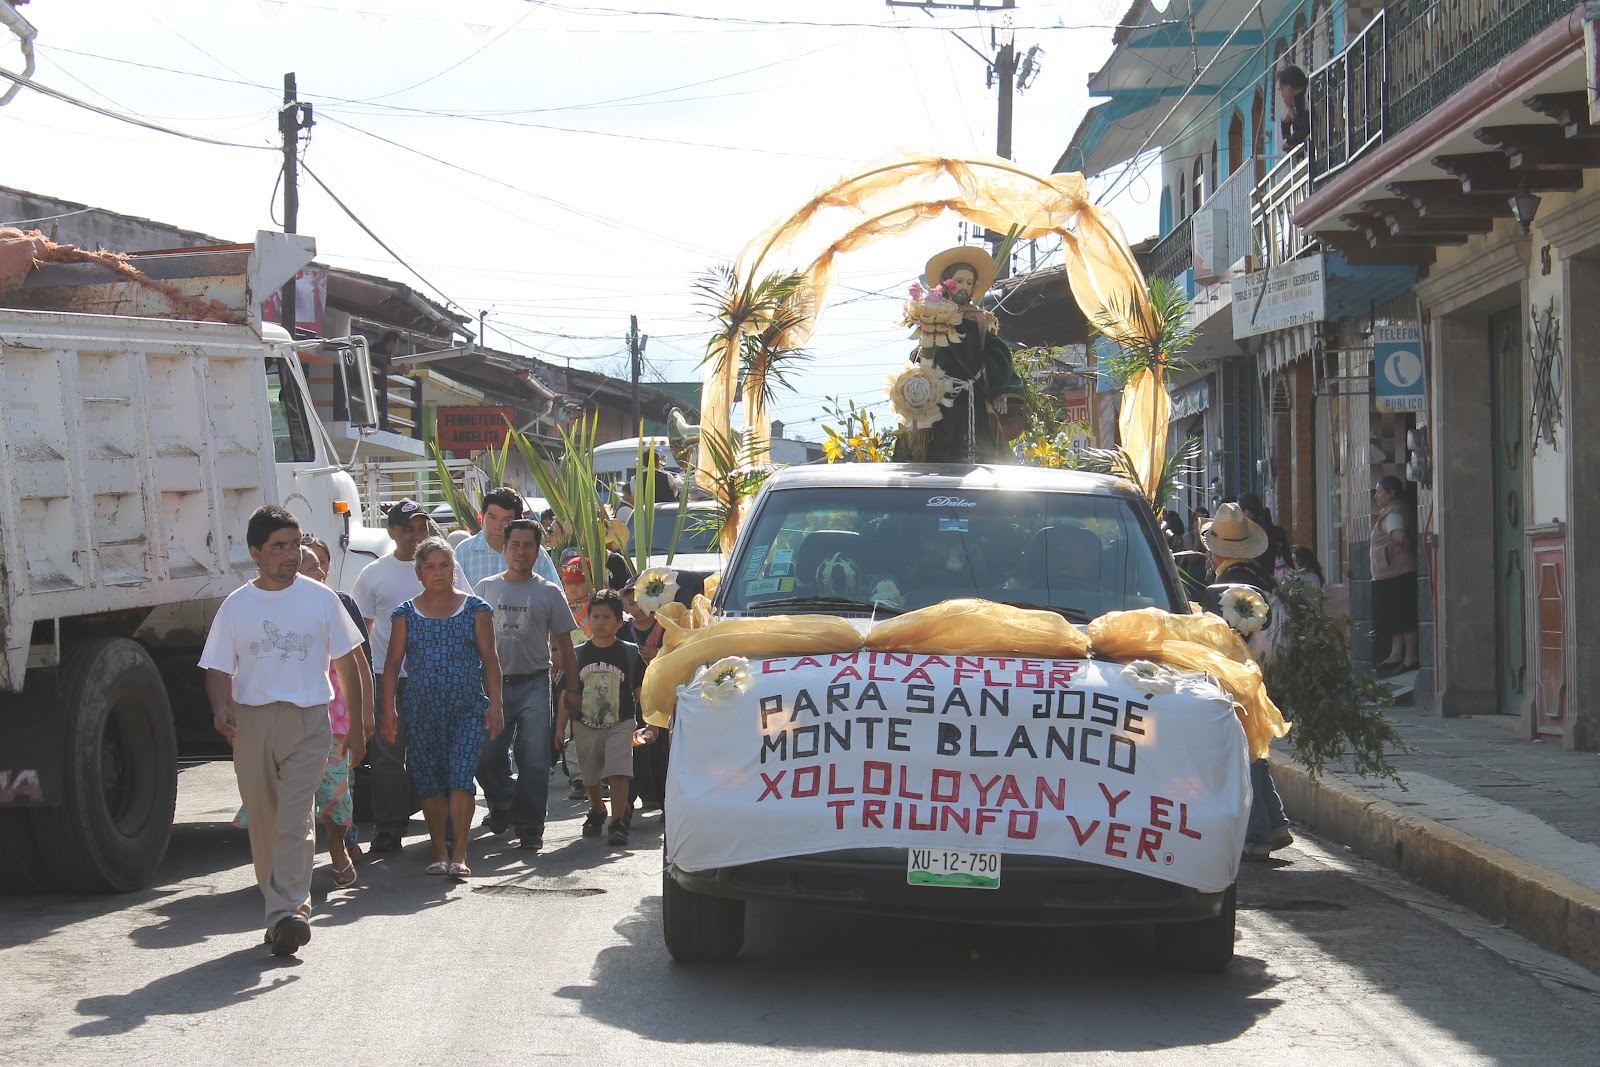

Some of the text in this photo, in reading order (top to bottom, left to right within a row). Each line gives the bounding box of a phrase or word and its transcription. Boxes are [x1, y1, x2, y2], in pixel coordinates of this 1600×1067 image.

[1379, 328, 1419, 341] TELEFON
[1385, 397, 1423, 410] PUBLICO
[497, 604, 528, 612] SAINTS
[761, 652, 1079, 674] CAMINANTES
[953, 668, 1071, 688] FLOR
[760, 682, 1155, 736] PARA SAN JOSÉ
[760, 717, 1136, 774] MONTE BLANCO
[756, 761, 1202, 840] XOLOLOYAN Y EL
[827, 800, 1174, 865] TRIUNFO VER.
[912, 849, 997, 872] XU-12-750
